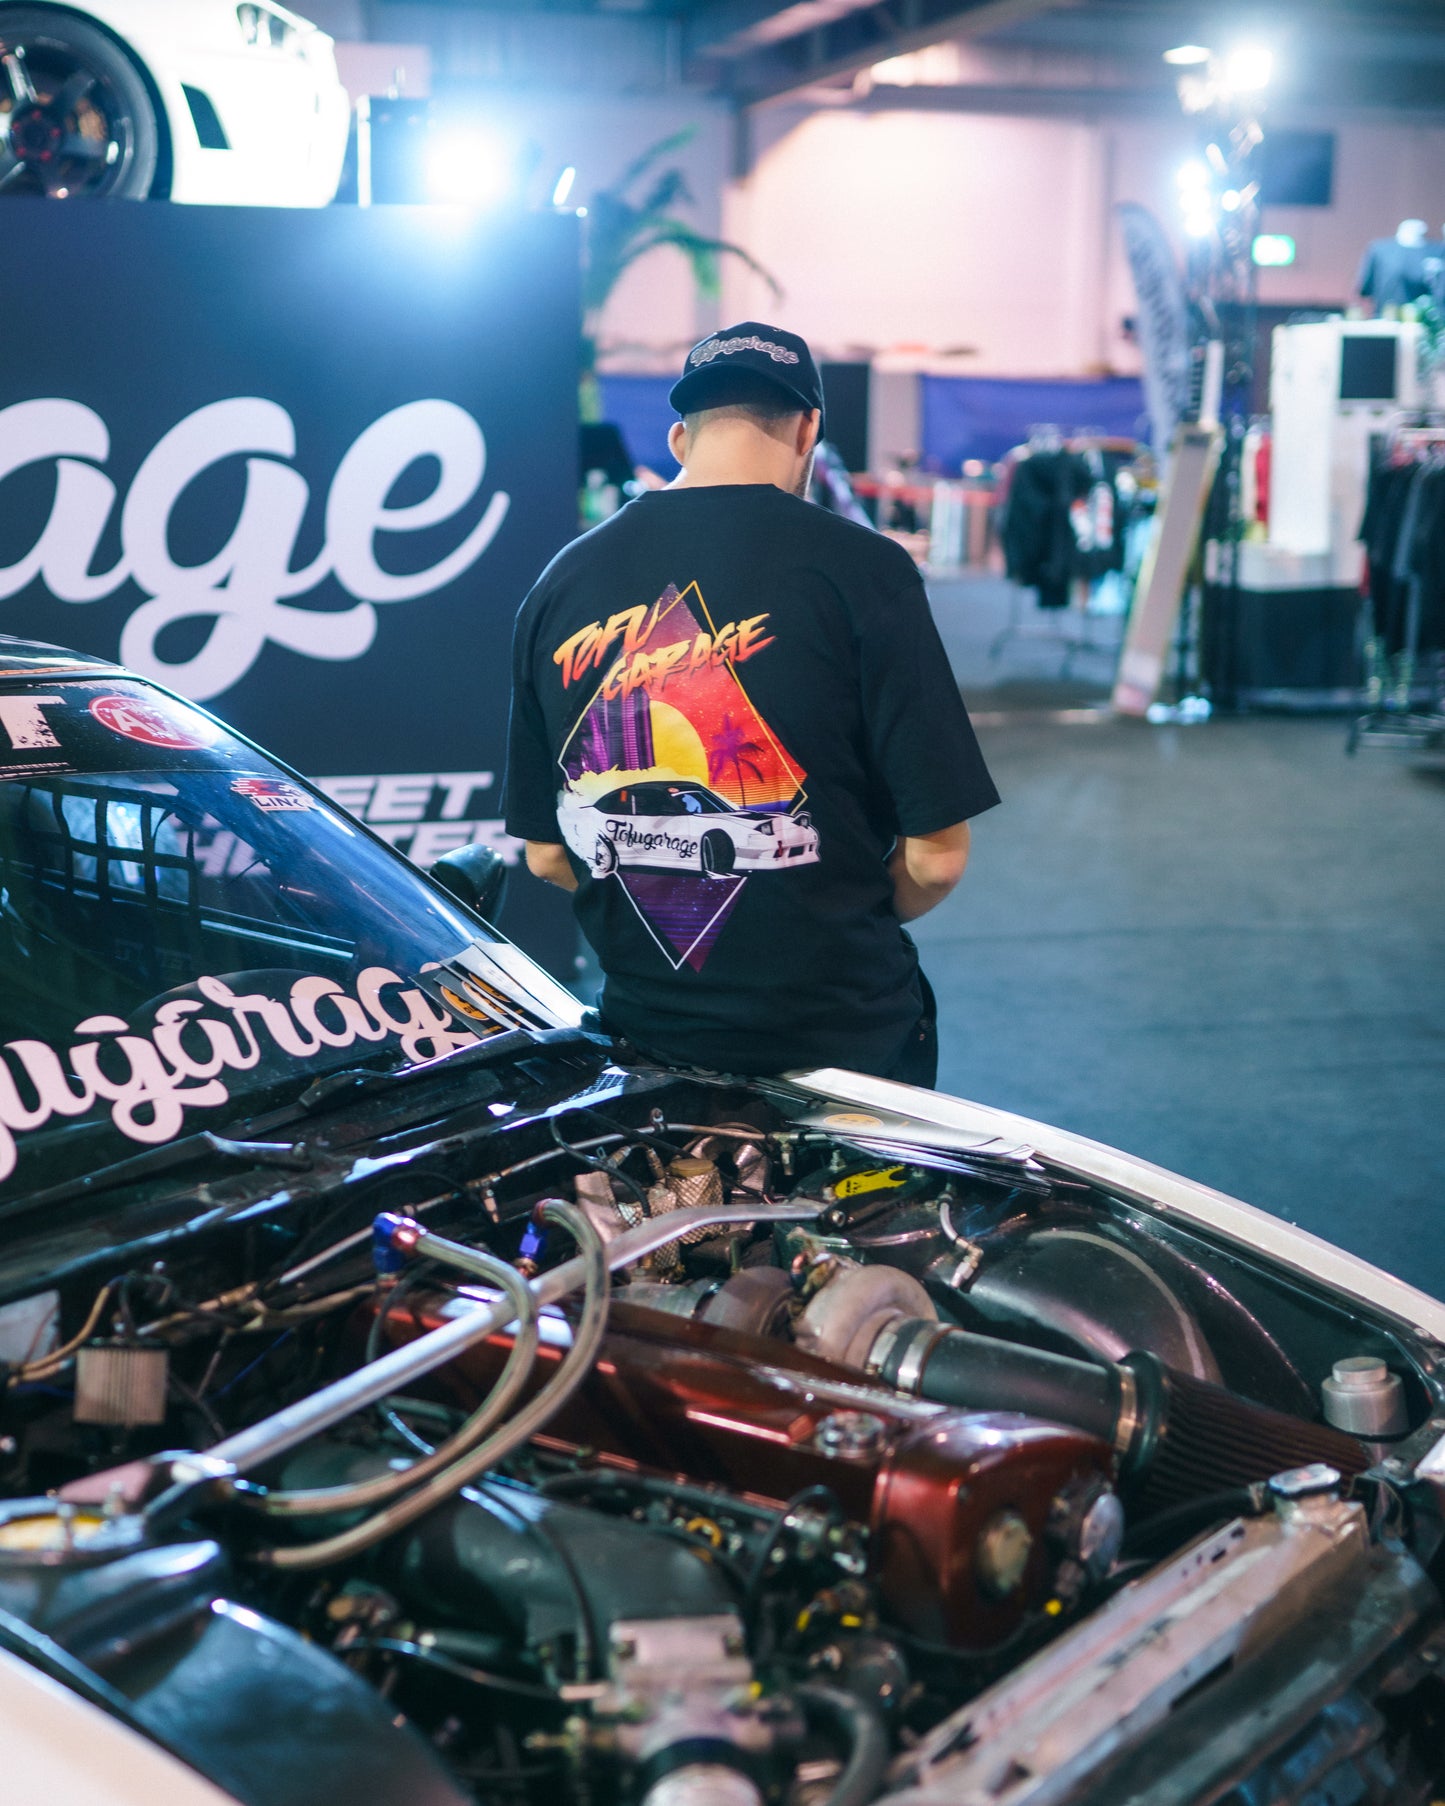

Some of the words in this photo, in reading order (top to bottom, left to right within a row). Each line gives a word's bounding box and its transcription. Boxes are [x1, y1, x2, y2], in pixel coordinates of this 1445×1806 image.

[553, 597, 664, 690] TOFU
[603, 613, 777, 701] GARAGE
[606, 819, 698, 859] Tofugarage
